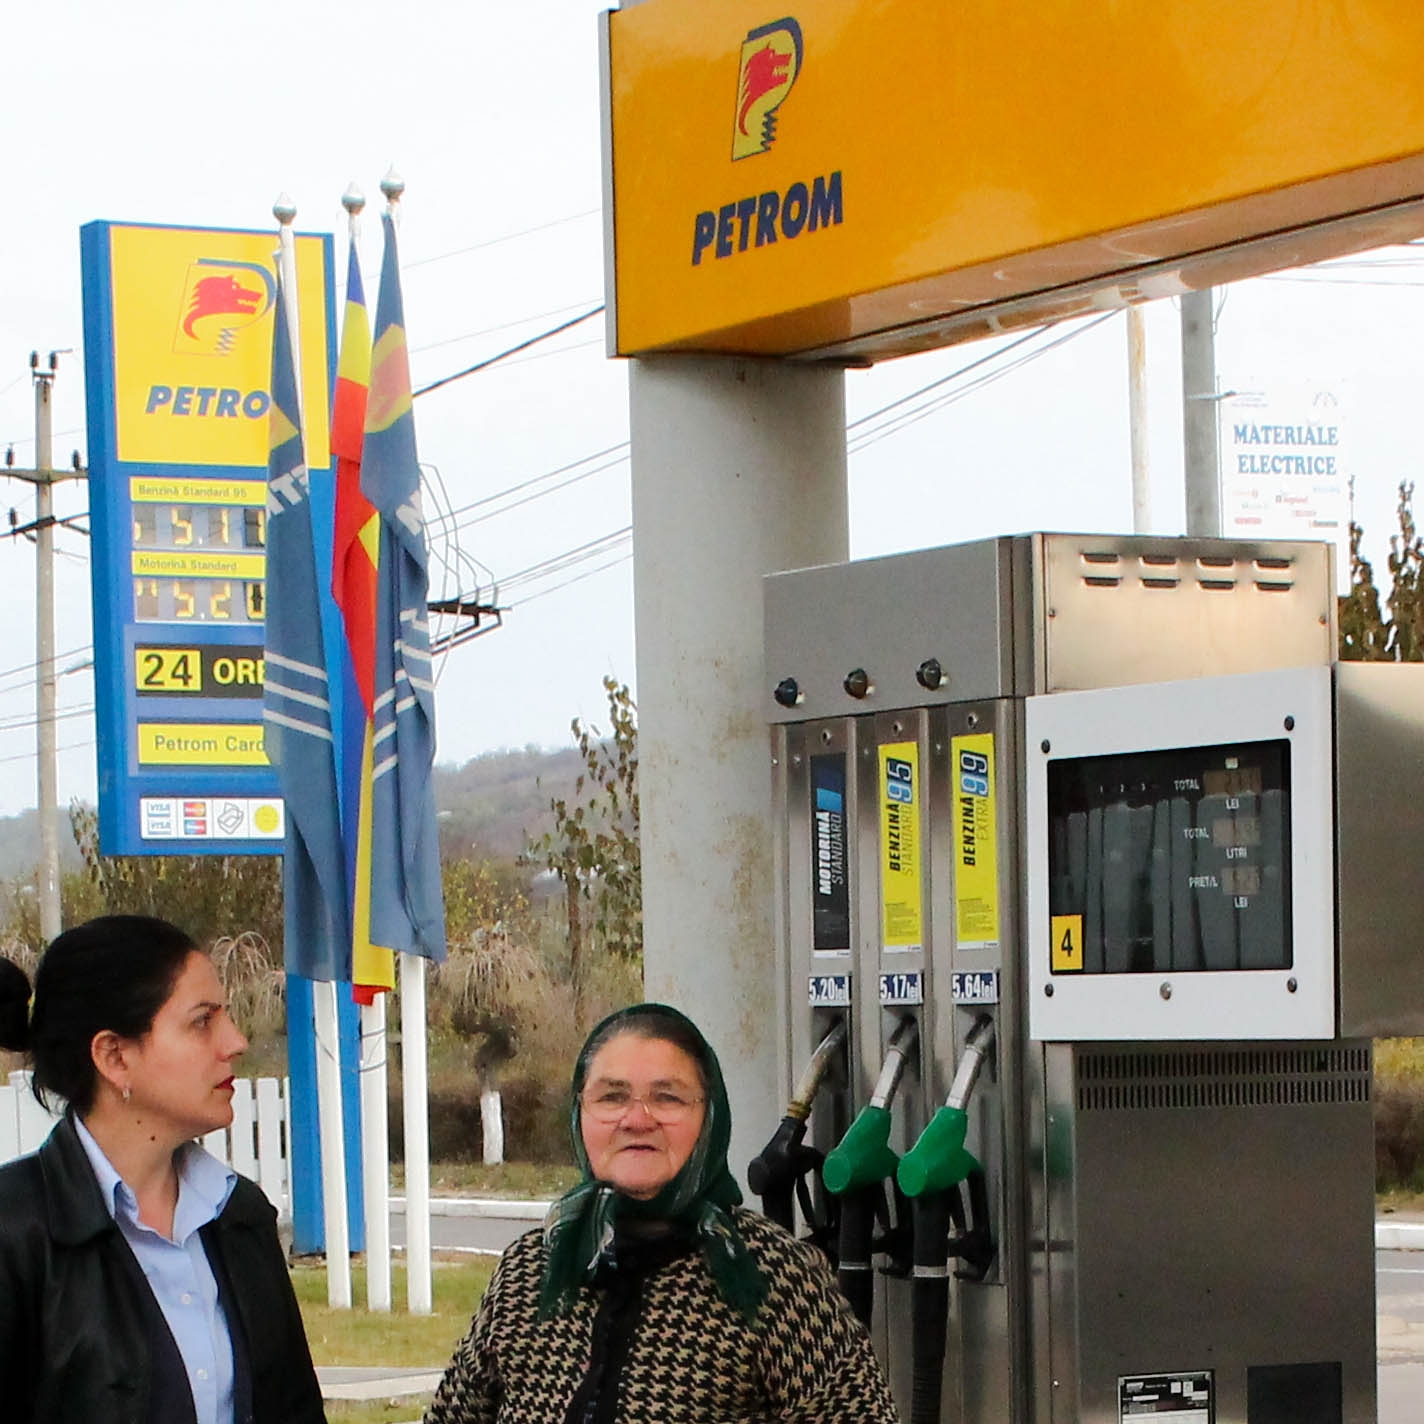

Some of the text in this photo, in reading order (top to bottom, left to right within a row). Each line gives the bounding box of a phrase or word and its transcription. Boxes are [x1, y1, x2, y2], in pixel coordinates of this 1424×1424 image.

[691, 170, 844, 267] PETROM
[1233, 424, 1339, 446] MATERIALE
[1237, 454, 1337, 476] ELECTRICE
[183, 485, 230, 498] Standard
[190, 560, 238, 572] Standard
[143, 653, 193, 688] 24
[154, 735, 218, 752] Petrom
[886, 760, 912, 802] 95
[960, 752, 988, 797] 99
[1173, 778, 1200, 791] TOTAL
[976, 799, 991, 841] EXTRA
[1183, 827, 1210, 840] TOTAL
[830, 813, 844, 885] STANDARD
[900, 805, 914, 877] STANDARD
[1061, 928, 1074, 958] 4
